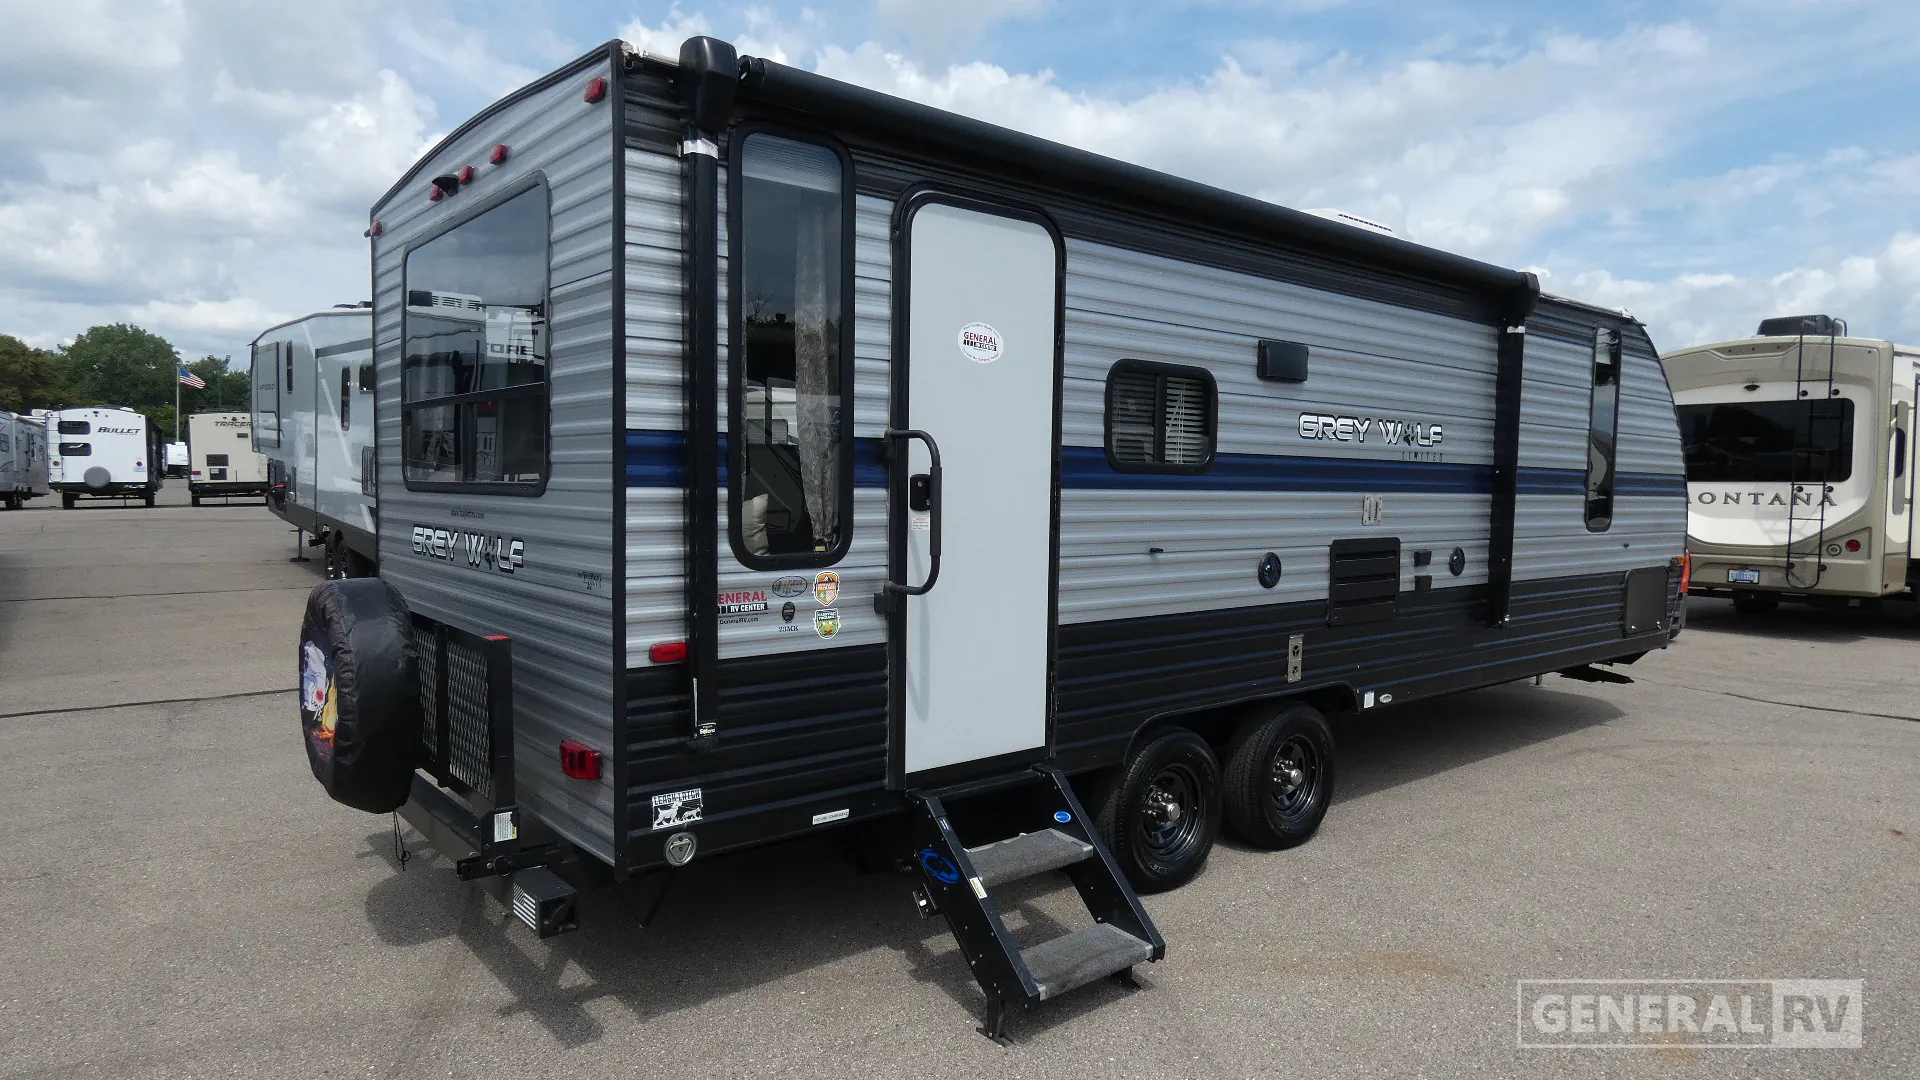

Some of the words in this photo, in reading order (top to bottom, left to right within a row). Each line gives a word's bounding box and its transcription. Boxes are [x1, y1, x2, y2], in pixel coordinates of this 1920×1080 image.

[963, 331, 998, 346] GENERAL
[97, 426, 142, 434] BULLET
[1298, 412, 1371, 443] GREY
[1401, 451, 1444, 462] LIMITED
[1687, 491, 1837, 507] ONTANA
[412, 523, 459, 561] GREY
[717, 590, 768, 605] ENERAL
[730, 605, 740, 613] RV
[740, 603, 766, 612] CENTER
